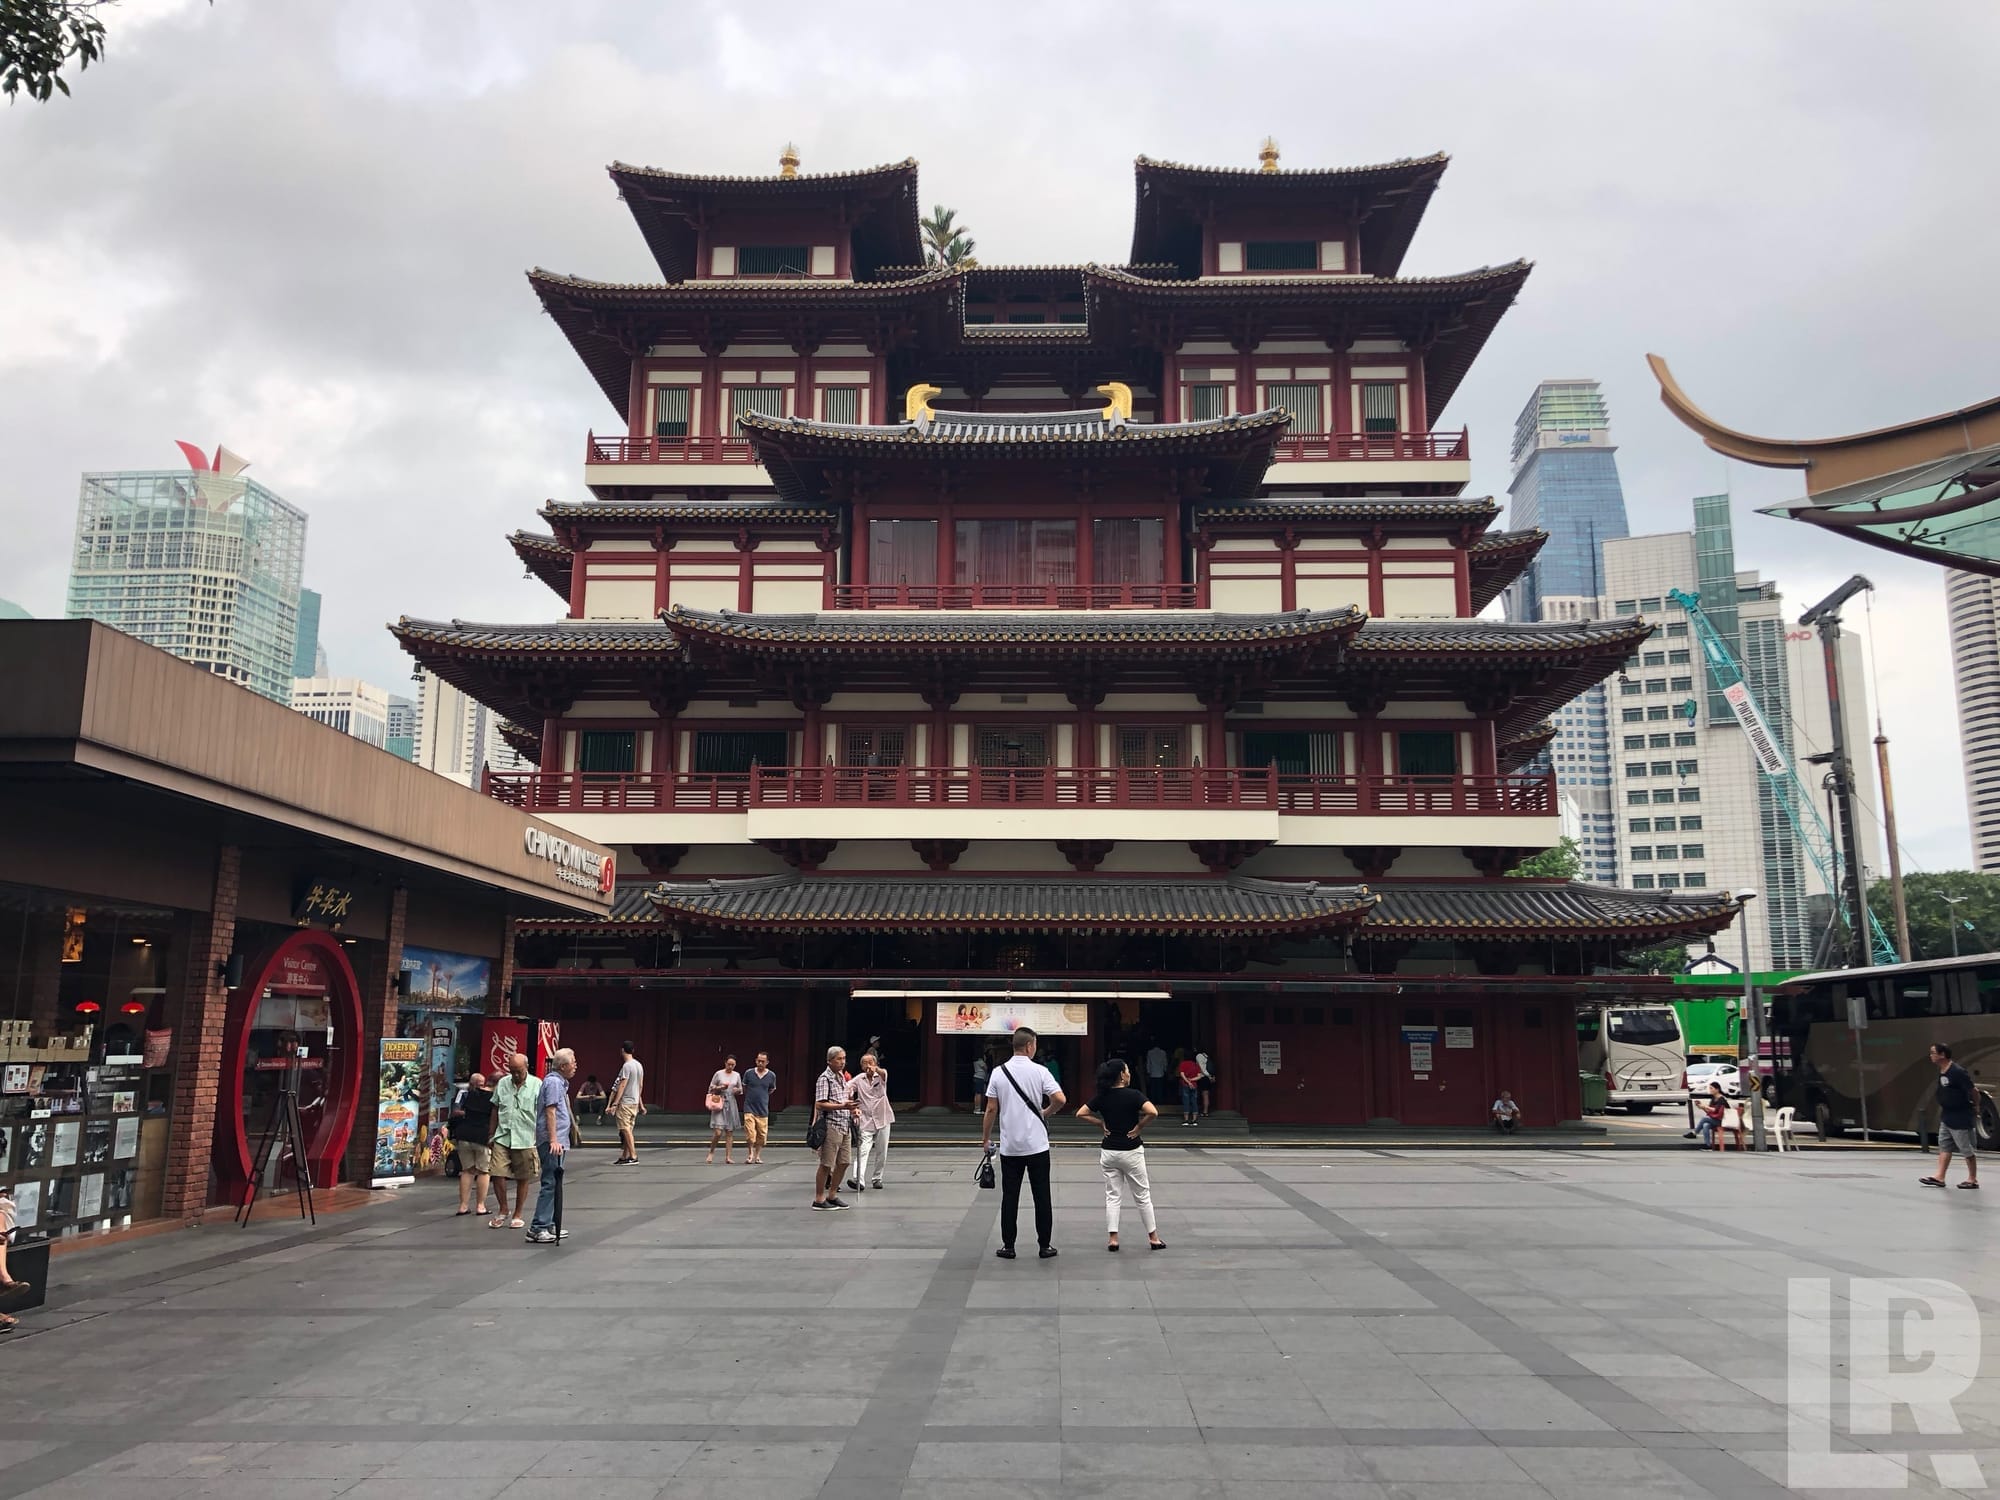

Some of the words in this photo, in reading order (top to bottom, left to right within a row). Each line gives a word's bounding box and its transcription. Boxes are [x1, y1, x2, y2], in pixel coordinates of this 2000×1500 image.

[1736, 701, 1758, 729] PINTARY
[1750, 727, 1782, 771] FOUNDATIONS
[525, 827, 587, 875] CHINATOWN
[283, 956, 300, 969] Visitor
[300, 959, 317, 972] Centre
[384, 1042, 408, 1052] TICKETS
[408, 1042, 417, 1052] ON
[384, 1051, 400, 1060] SALE
[400, 1051, 416, 1060] HERE
